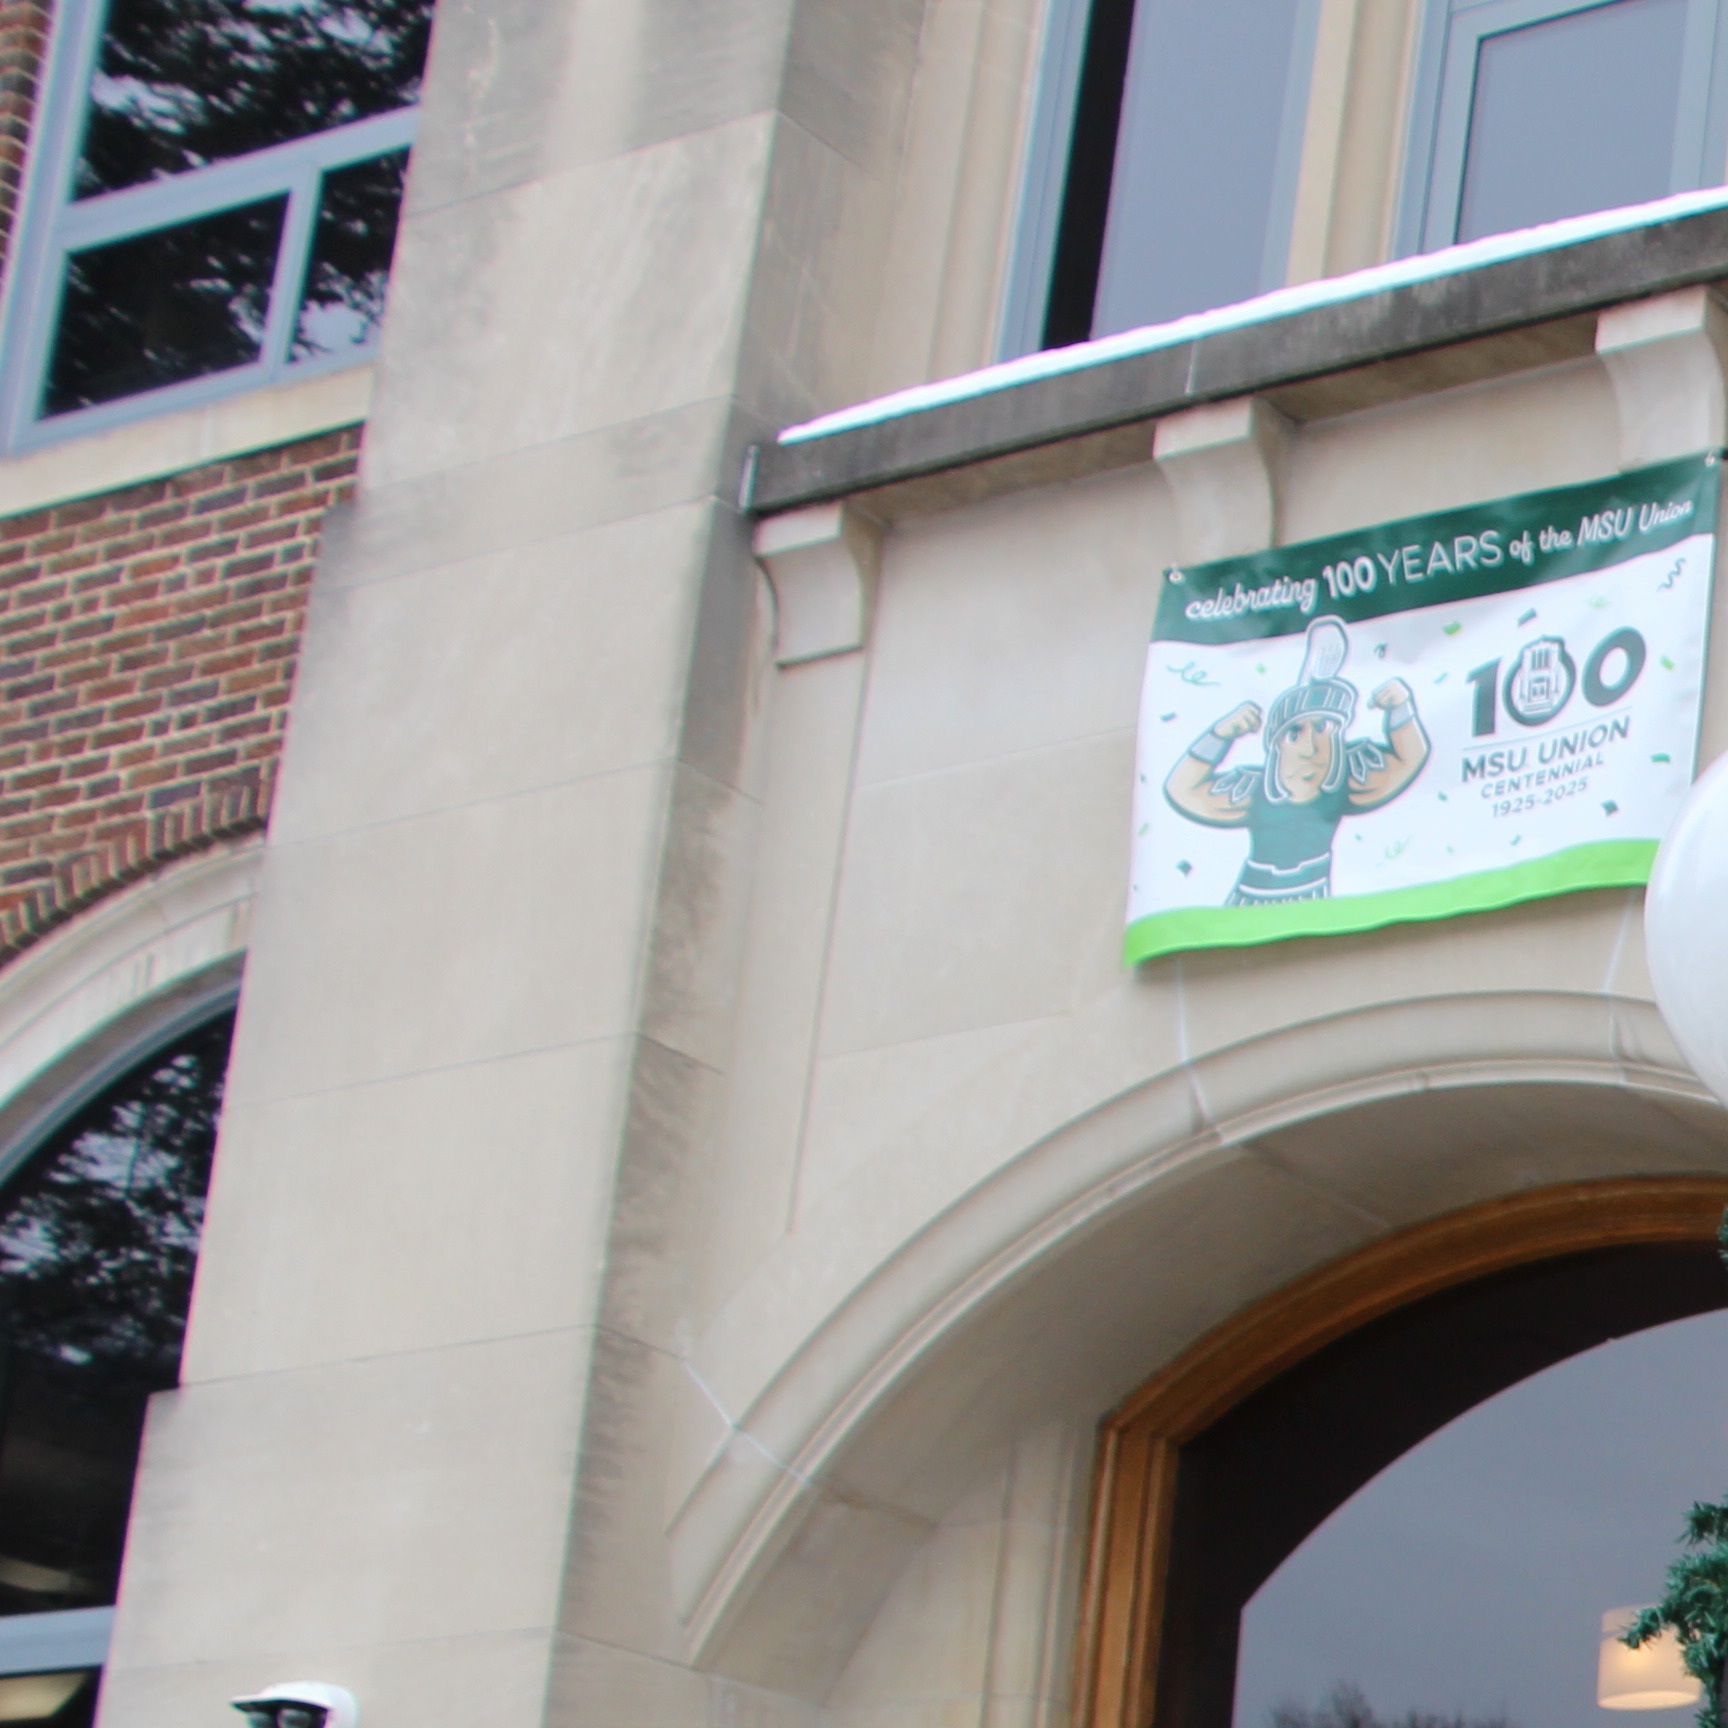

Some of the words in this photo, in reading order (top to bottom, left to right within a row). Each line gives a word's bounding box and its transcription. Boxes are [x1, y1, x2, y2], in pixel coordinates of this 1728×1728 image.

[1184, 574, 1318, 621] celebrating
[1322, 555, 1378, 600] 100
[1376, 529, 1501, 586] YEARS
[1508, 529, 1534, 565] of
[1539, 525, 1573, 550] the
[1577, 503, 1634, 547] MSU
[1637, 499, 1693, 532] Union
[1464, 625, 1648, 738] 100
[1461, 746, 1528, 783] MSU
[1538, 714, 1631, 765] UNION
[1480, 751, 1604, 799] CENTENNIAL
[1492, 775, 1589, 818] 1925-2025
